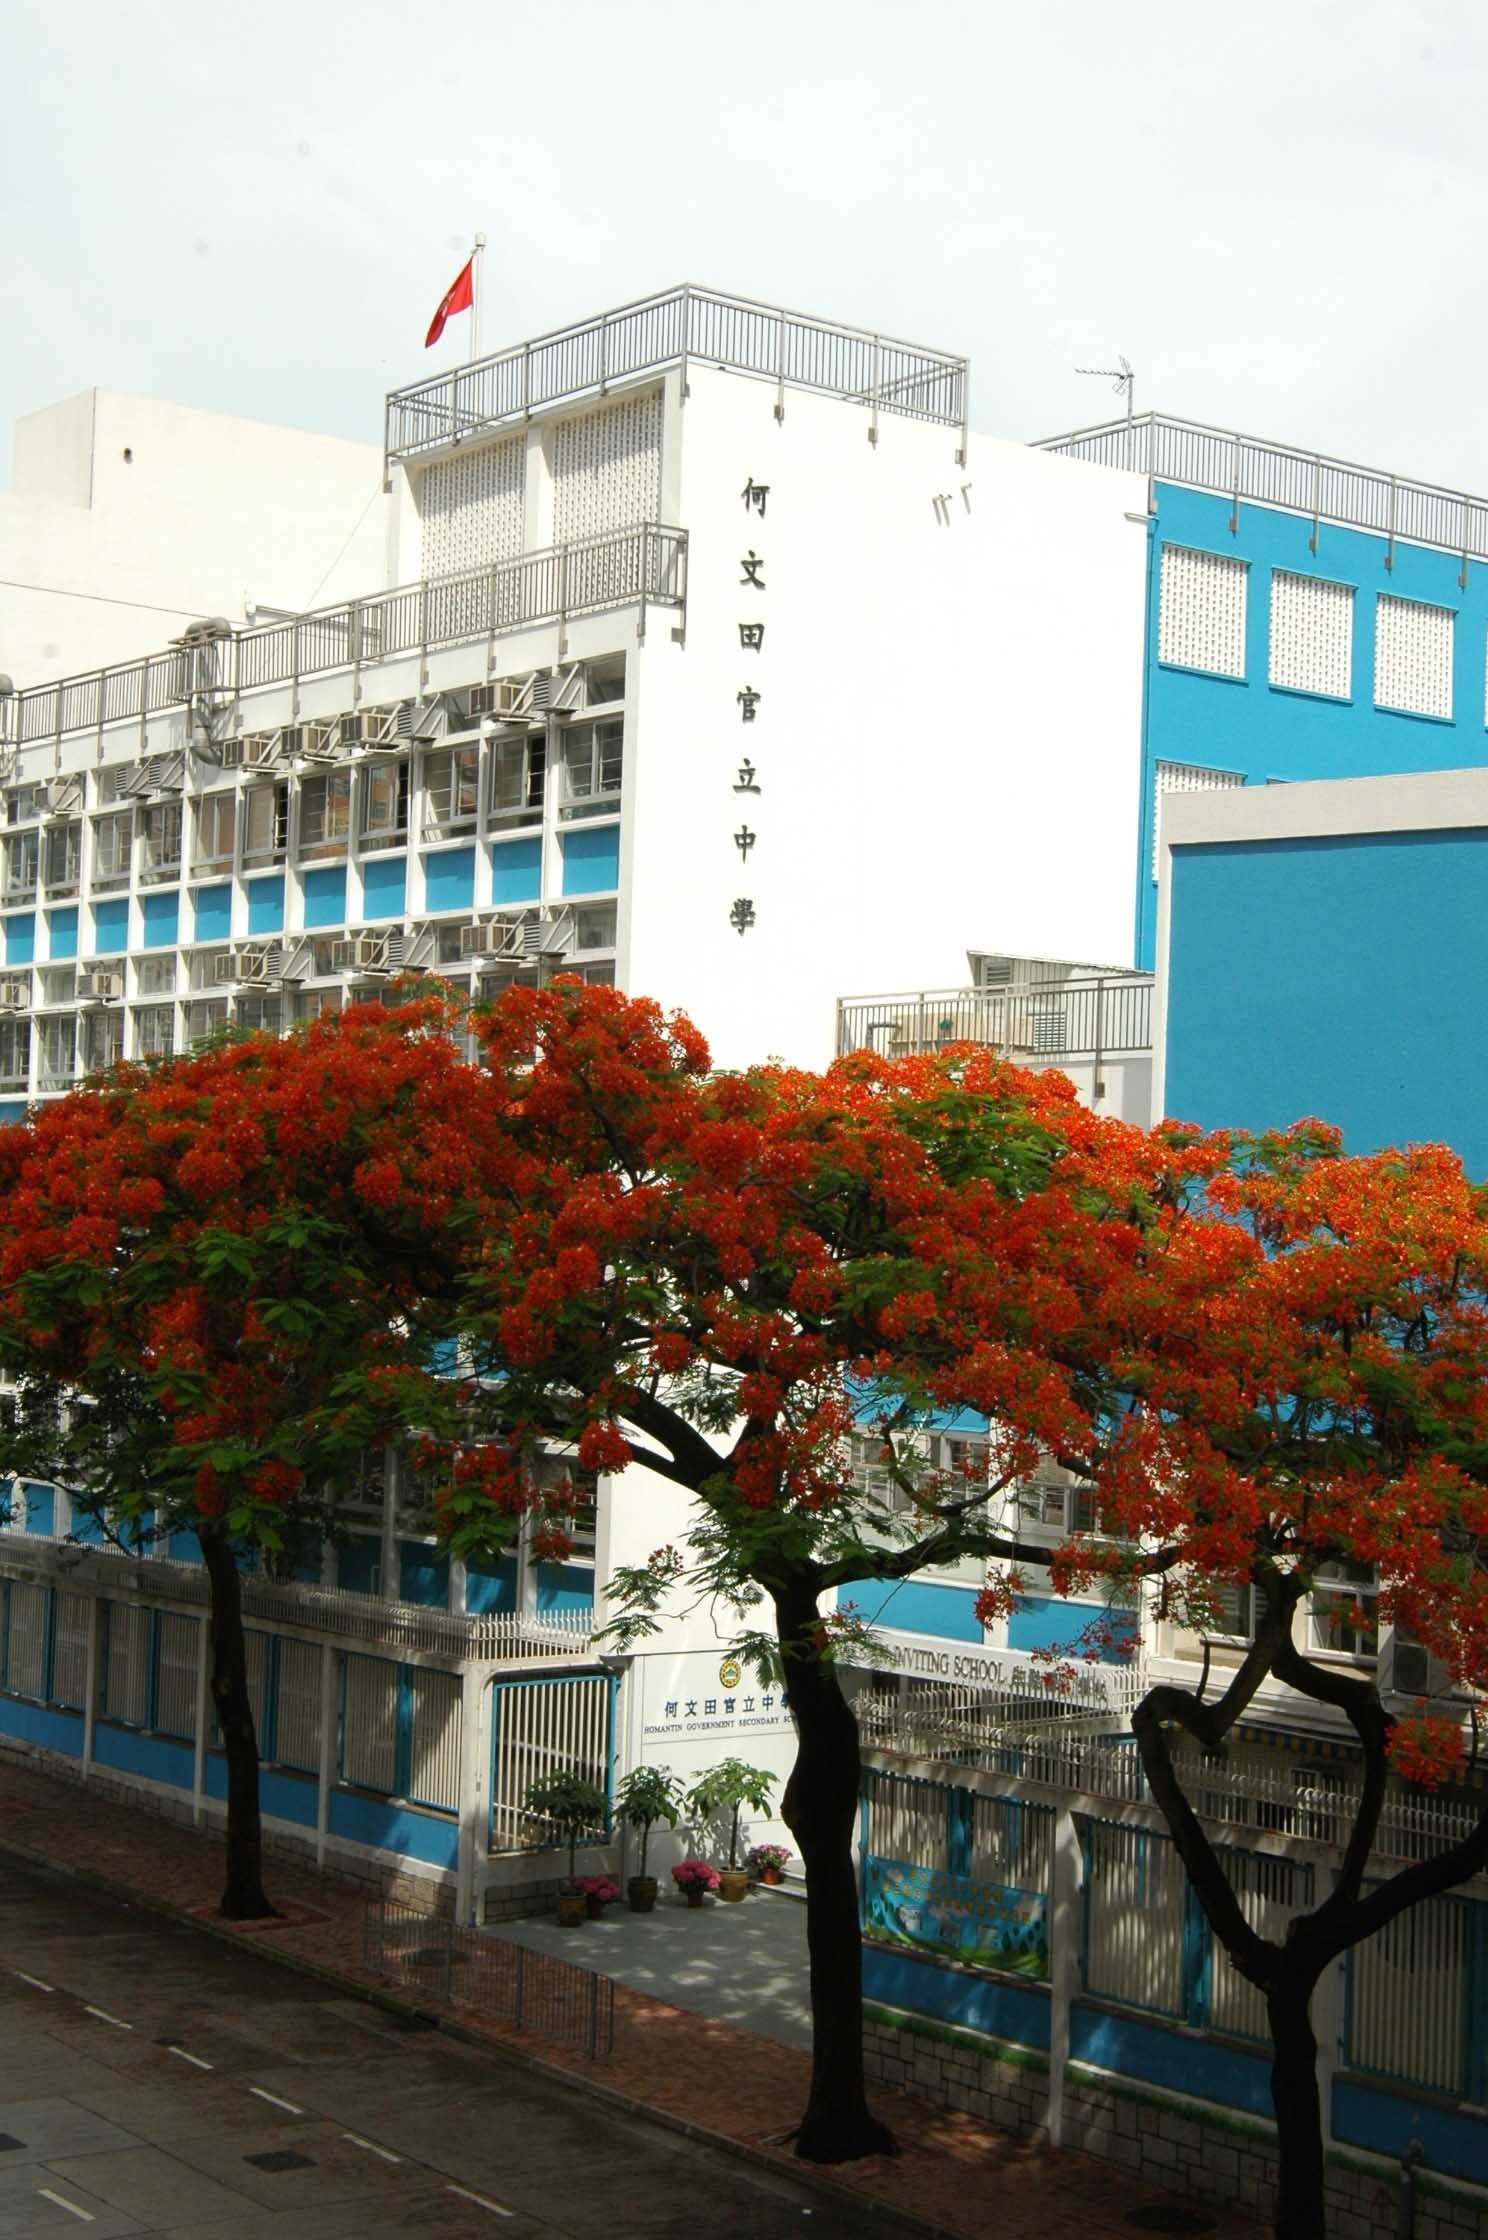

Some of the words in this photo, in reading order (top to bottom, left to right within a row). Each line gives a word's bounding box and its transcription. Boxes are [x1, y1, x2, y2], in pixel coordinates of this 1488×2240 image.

[729, 477, 770, 936] 何文田官立中學
[890, 1644, 949, 1675] NVITING
[954, 1655, 1008, 1684] SCHOOL
[686, 1719, 735, 1731] GOVERNMENT
[739, 1716, 779, 1727] SECONDARY
